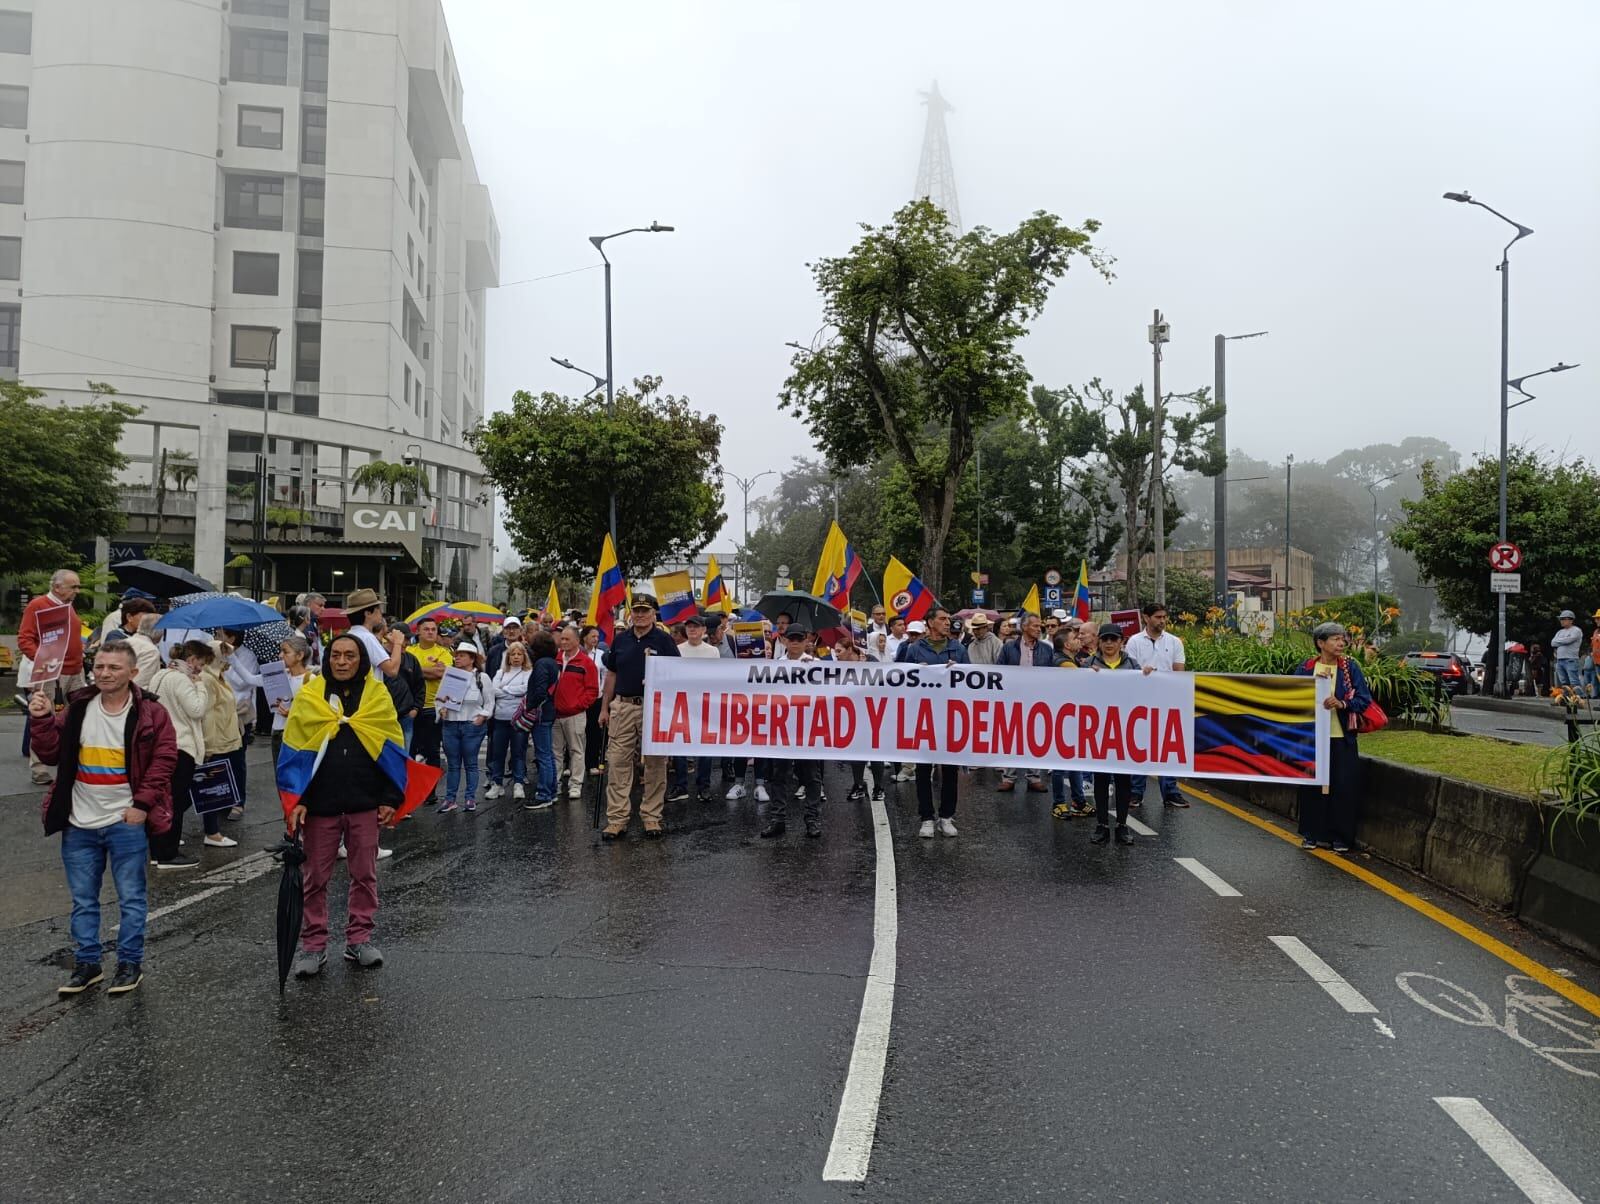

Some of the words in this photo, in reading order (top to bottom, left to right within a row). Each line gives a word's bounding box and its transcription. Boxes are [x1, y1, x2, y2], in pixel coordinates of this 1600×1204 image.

[352, 508, 416, 532] CAI
[109, 547, 136, 558] BVA
[747, 665, 943, 688] MARCHAMOS...
[949, 670, 1004, 690] POR
[651, 691, 691, 744] LA
[701, 692, 857, 749] LIBERTAD
[865, 696, 888, 749] Y
[896, 697, 937, 751] LA
[946, 698, 1187, 764] DEMOCRACIA
